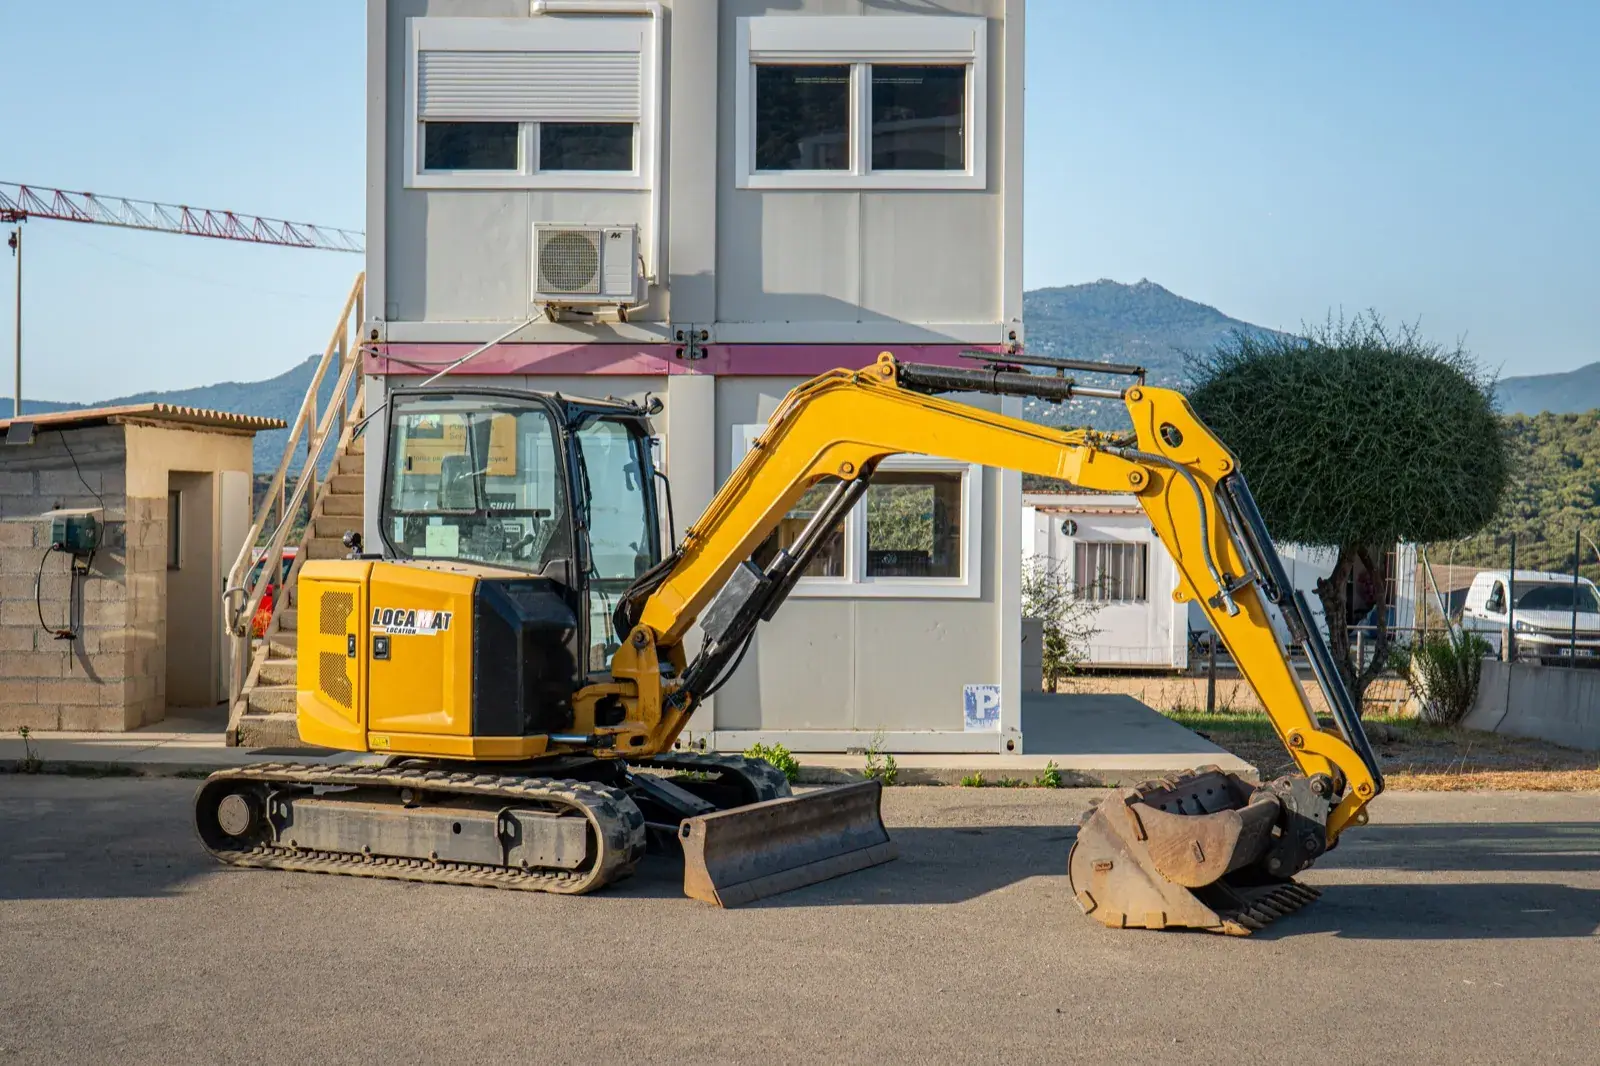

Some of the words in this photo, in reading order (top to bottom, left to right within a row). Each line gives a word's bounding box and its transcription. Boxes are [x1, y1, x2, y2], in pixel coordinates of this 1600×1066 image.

[372, 607, 452, 630] LOCAMAT
[386, 626, 417, 635] LOCATION
[976, 690, 999, 719] P
